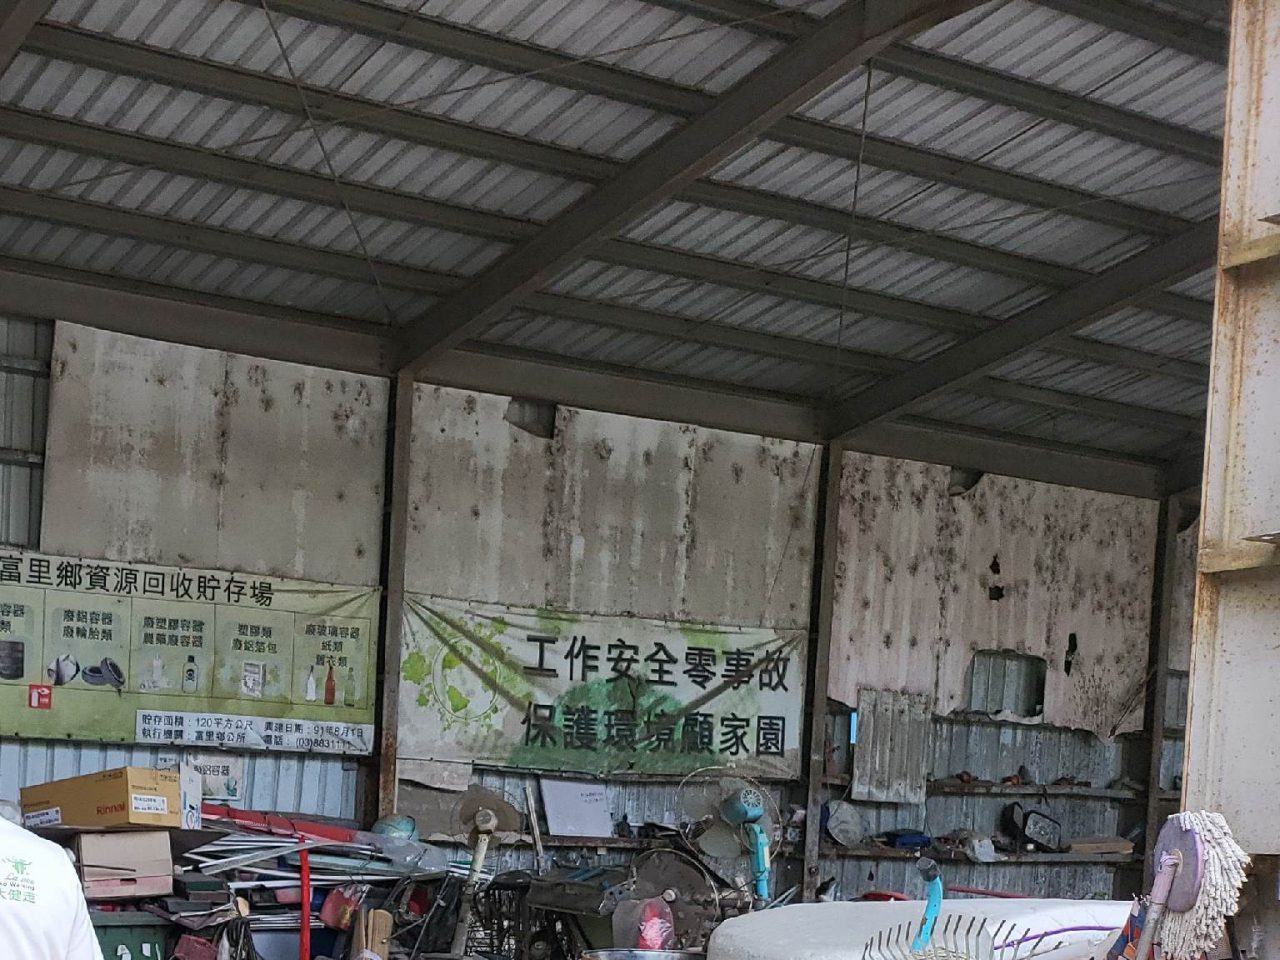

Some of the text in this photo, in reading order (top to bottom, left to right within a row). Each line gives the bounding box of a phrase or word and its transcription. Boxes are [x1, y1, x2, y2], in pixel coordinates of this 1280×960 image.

[523, 634, 790, 693] 工作安全零事故
[521, 701, 786, 758] 保護環境顧家園
